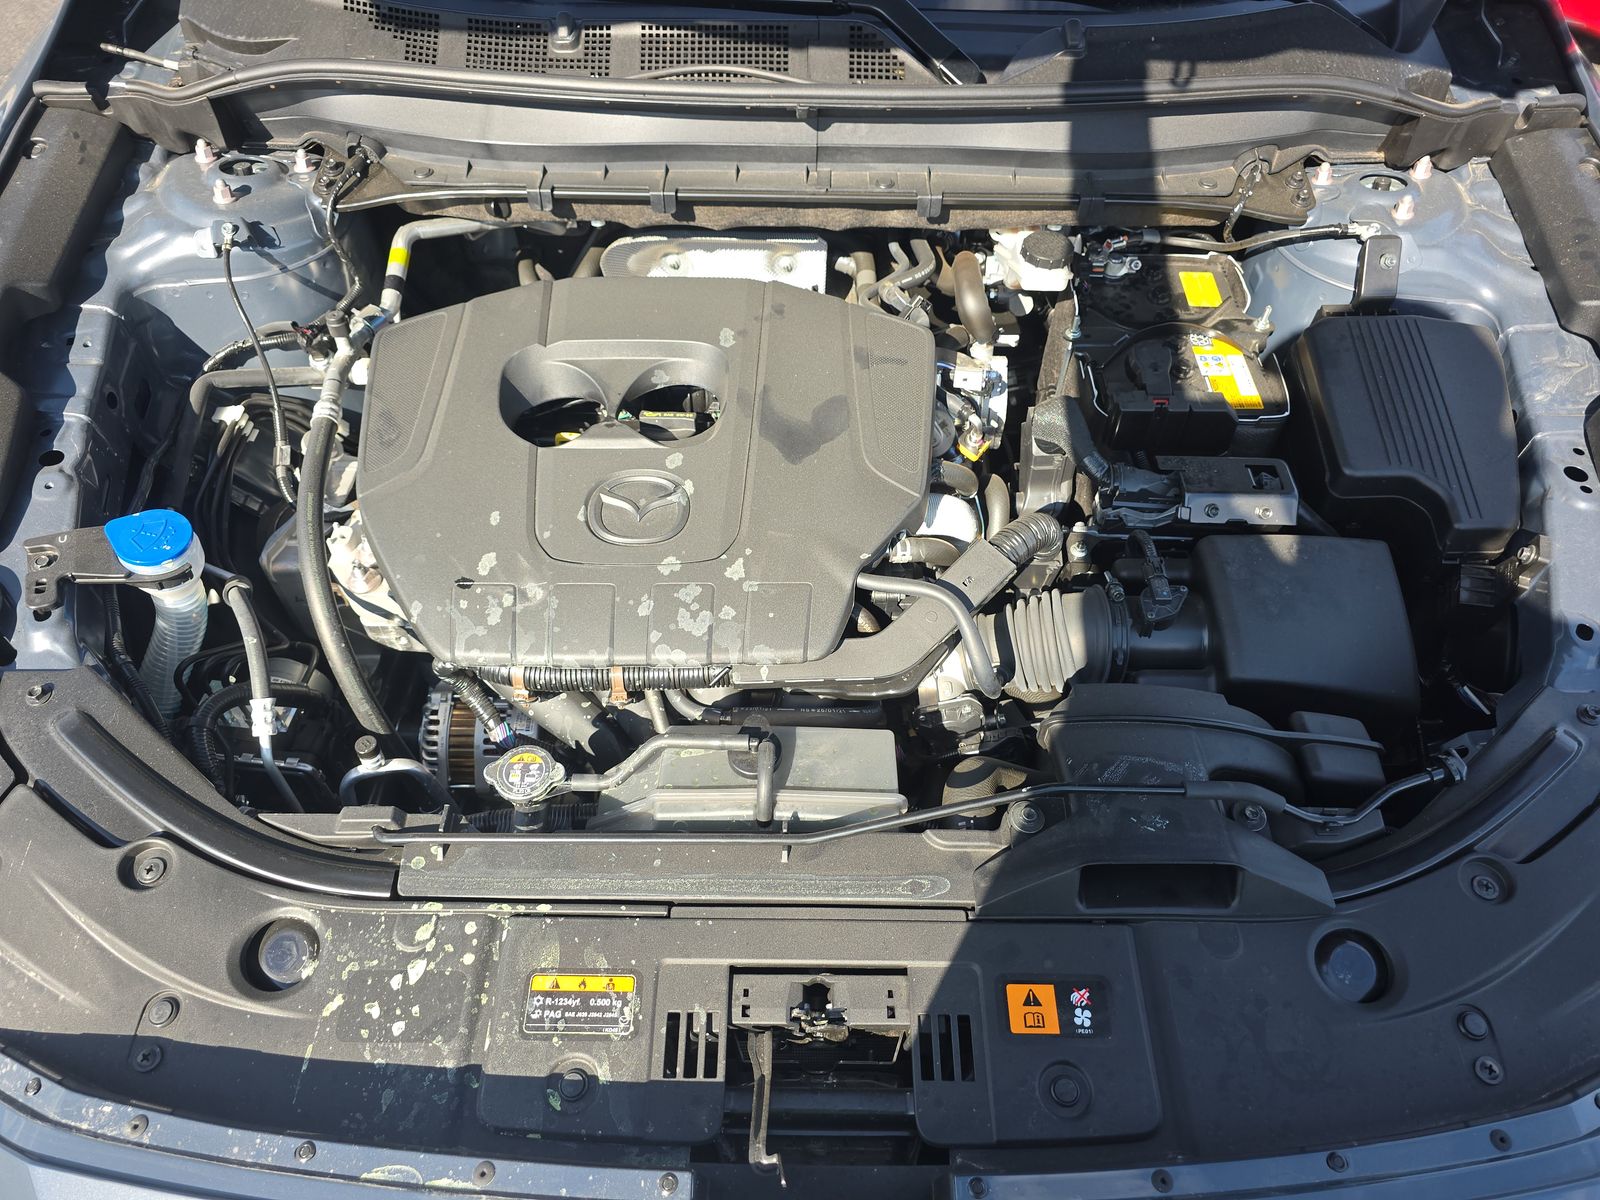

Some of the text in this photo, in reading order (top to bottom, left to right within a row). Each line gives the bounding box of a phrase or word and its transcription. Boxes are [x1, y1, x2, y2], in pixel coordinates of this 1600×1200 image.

[545, 997, 622, 1007] R-1234yf 0.500 kg
[543, 1010, 562, 1018] PAG
